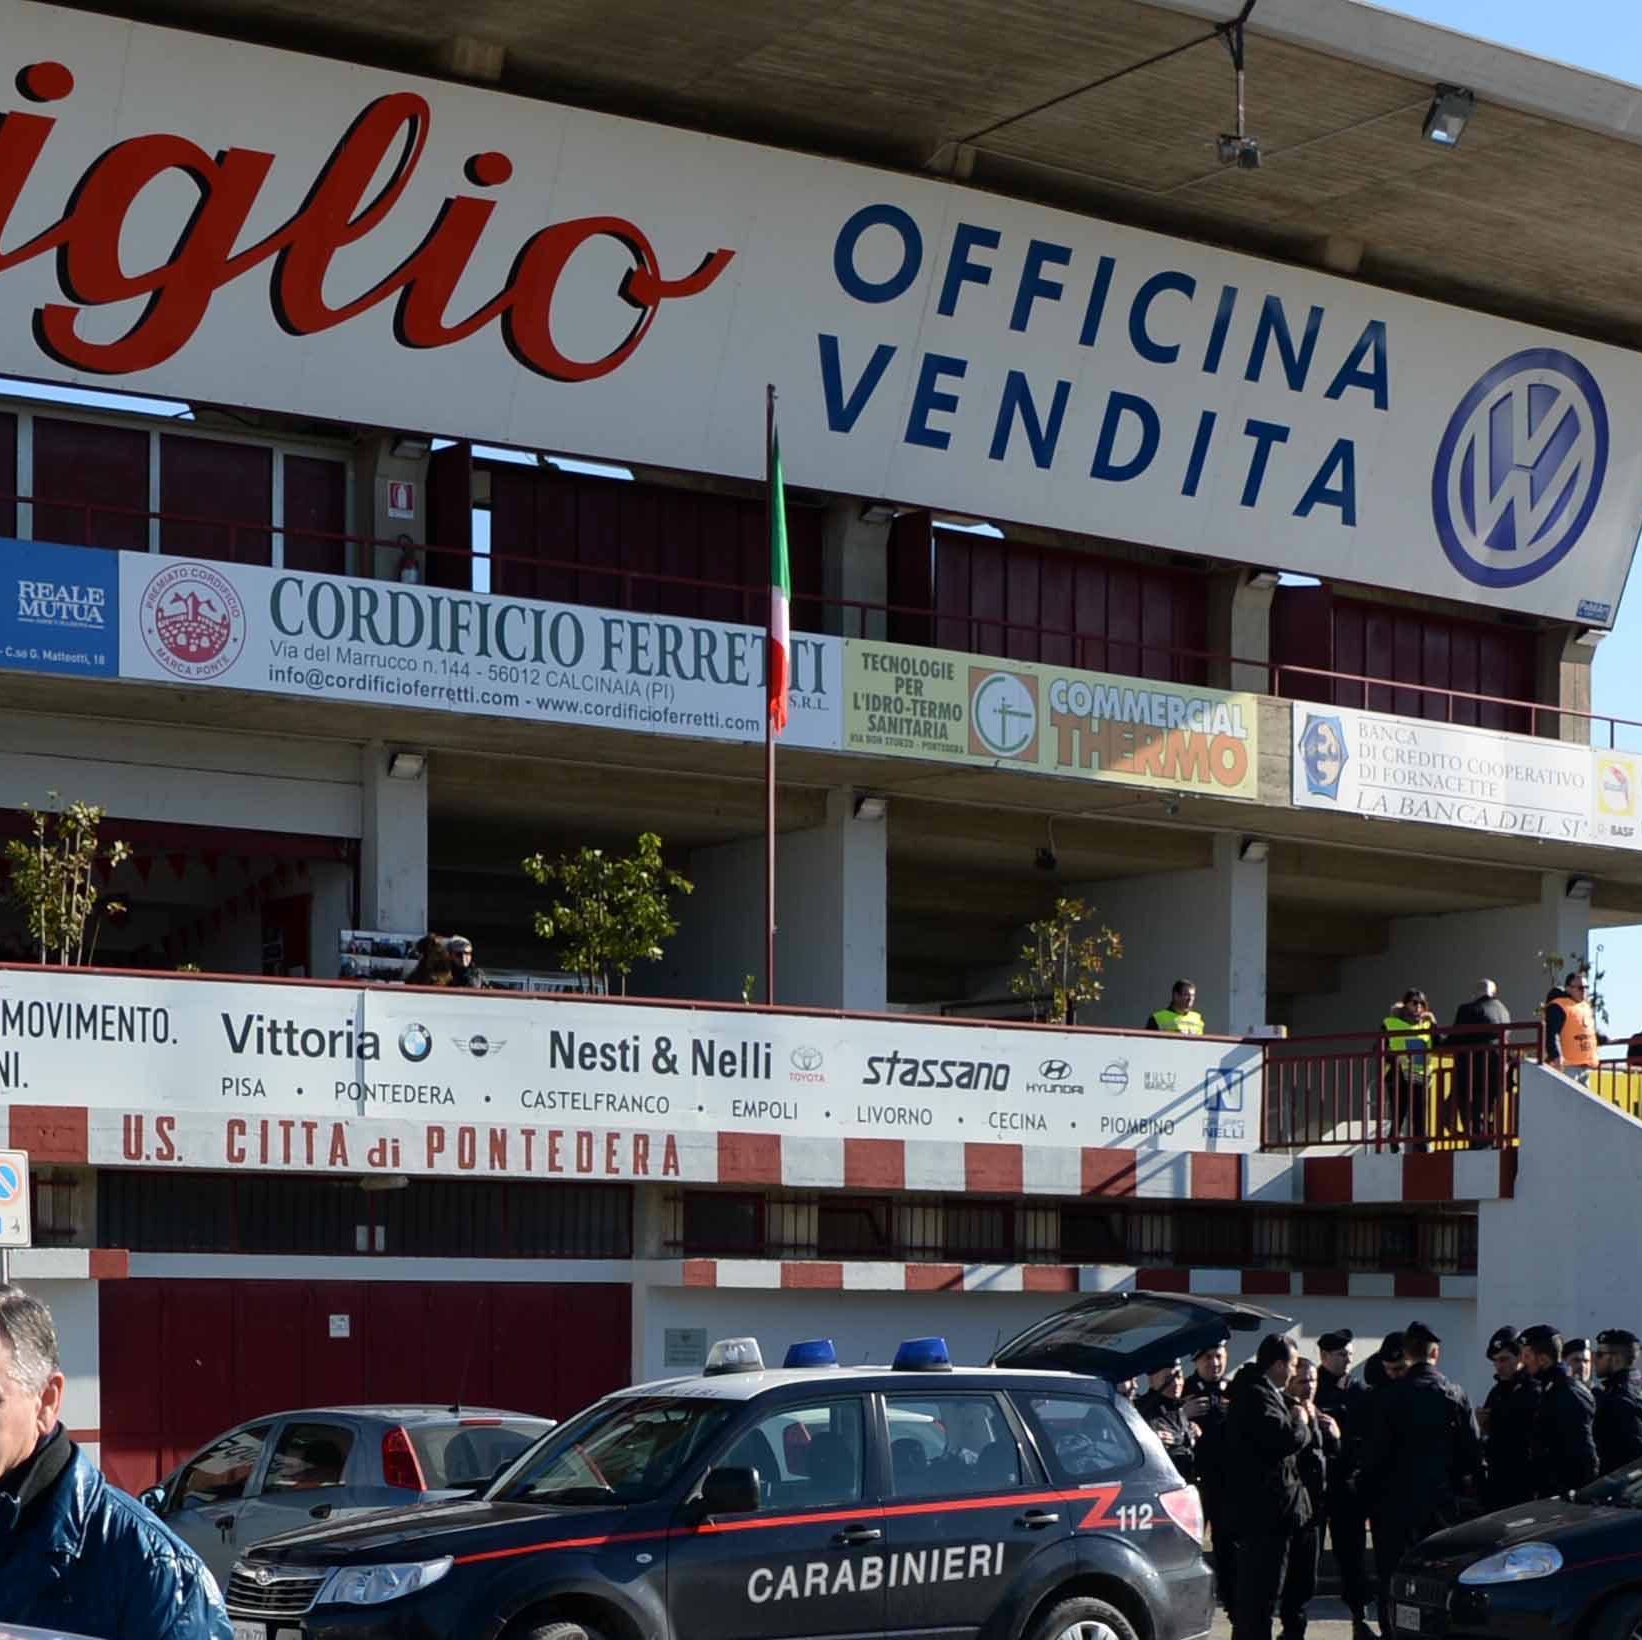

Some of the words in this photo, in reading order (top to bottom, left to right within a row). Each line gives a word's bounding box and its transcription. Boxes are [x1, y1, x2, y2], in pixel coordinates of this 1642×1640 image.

[834, 203, 1391, 411] OFFICINA
[818, 333, 1357, 527] VENDITA
[17, 580, 105, 606] REALE
[145, 568, 188, 609] PREMIATO
[191, 568, 240, 618] CORDIFICIO
[17, 600, 105, 623] MUTUA
[269, 575, 584, 668] CORDIFICIO
[156, 647, 192, 675] MARCA
[196, 654, 230, 675] PONTE
[269, 639, 300, 661] Via
[304, 641, 332, 663] del
[336, 646, 418, 672] Marrucco
[423, 652, 471, 678] n.144
[488, 664, 541, 687] 56012
[545, 669, 641, 698] CALCINAIA
[646, 679, 675, 703] (PI)
[861, 652, 956, 681] TECNOLOGIE
[268, 664, 519, 708] info@cordificioferretti.com
[537, 694, 759, 733] www.cordificioferretti.com
[895, 676, 924, 697] PER
[853, 692, 963, 722] L'IDRO-TERMO
[1049, 678, 1248, 740] COMMERCIAL
[868, 714, 949, 740] SANITARIA
[1358, 722, 1419, 746] BANCA
[1049, 710, 1248, 787] THERMO
[1358, 742, 1378, 760] DI
[1382, 745, 1463, 770] CREDITO
[1466, 758, 1586, 790] COOPERATIVO
[1358, 763, 1378, 780] DI
[1382, 766, 1500, 798] FORNACETTE
[1357, 791, 1389, 814] LA
[1399, 796, 1490, 827] BANCA
[1493, 810, 1550, 835] DEL
[1, 1001, 178, 1045] MOVIMENTO.
[221, 1013, 380, 1062] Vittoria
[550, 1029, 640, 1074] Nesti
[652, 1036, 679, 1075] &
[692, 1039, 771, 1080] Nelli
[789, 1071, 825, 1083] TOYOTA
[863, 1050, 1010, 1092] stassano
[221, 1078, 267, 1098] PISA
[334, 1082, 455, 1105] PONTEDERA
[521, 1089, 669, 1114] CASTELFRANCO
[1026, 1081, 1084, 1095] HYUNDAI
[732, 1100, 798, 1121] EMPOLI
[857, 1105, 933, 1126] LIVORNO
[988, 1111, 1047, 1132] CECINA
[1100, 1116, 1175, 1136] PIOMBINO
[1202, 1128, 1245, 1140] NELLI
[123, 1115, 183, 1163] U.S.
[366, 1137, 401, 1169] di
[426, 1125, 681, 1177] PONTEDERA
[1116, 1501, 1152, 1532] 112
[746, 1540, 1006, 1605] CARABINIERI
